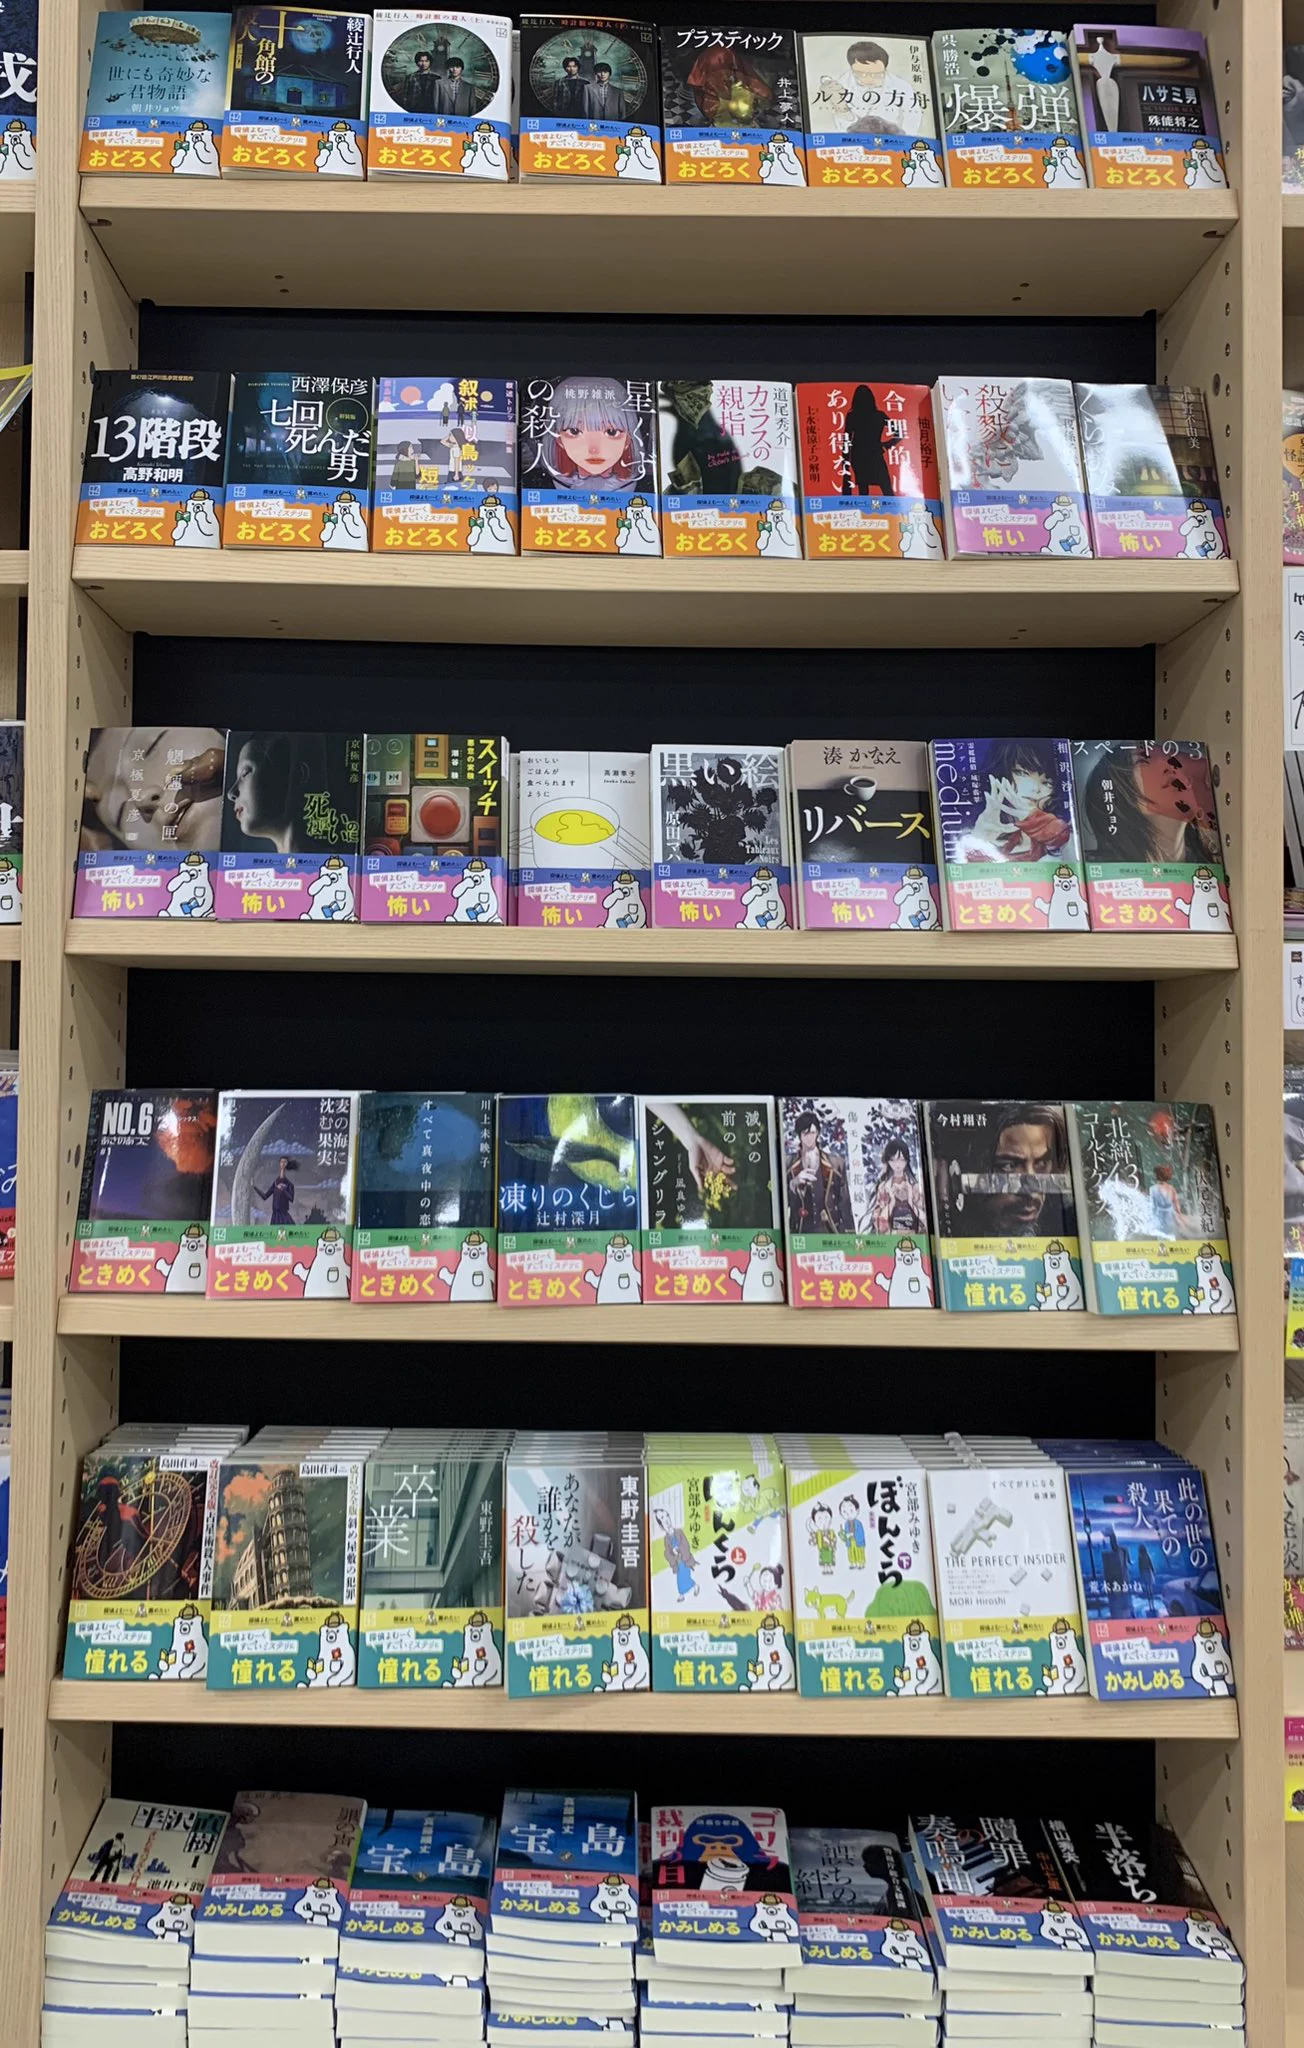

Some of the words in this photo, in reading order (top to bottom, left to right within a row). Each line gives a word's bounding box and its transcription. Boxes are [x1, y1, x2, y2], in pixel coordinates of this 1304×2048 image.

[345, 17, 364, 74] 綾辻行人
[676, 31, 784, 50] プラスティック
[109, 65, 211, 84] 世にも奇妙な
[128, 84, 187, 100] 君物語
[777, 78, 796, 125] 井上夢人
[812, 89, 930, 109] ルカの方舟
[1142, 85, 1198, 104] ハサミ男
[131, 103, 180, 113] 朝井リョウ
[945, 84, 1077, 131] 爆弾
[1148, 115, 1200, 128] 殊能将之
[88, 150, 164, 169] おどろく
[232, 145, 306, 168] おどろく
[378, 147, 451, 168] おどろく
[533, 152, 606, 171] おどろく
[678, 162, 750, 179] おどろく
[822, 167, 894, 184] おどろく
[963, 167, 1035, 185] おどろく
[1106, 167, 1177, 186] おどろく
[291, 376, 368, 395] 西澤保彦
[564, 387, 616, 401] 桃野雑派
[260, 399, 324, 428] 七回
[717, 385, 746, 437] 親指
[772, 387, 791, 447] 道尾秀介
[521, 379, 569, 476] の殺人
[620, 379, 657, 482] 星くず
[747, 385, 772, 461] カラスの
[90, 415, 222, 463] 13階段
[285, 426, 370, 457] 死んだ
[826, 389, 856, 493] あり得ない
[122, 467, 183, 482] 高野和明
[327, 453, 359, 482] 男
[90, 522, 164, 540] おどろく
[236, 522, 311, 542] おどろく
[385, 528, 459, 547] おどろく
[535, 528, 606, 548] おどろく
[983, 528, 1024, 548] 怖い
[1119, 532, 1161, 552] 怖い
[676, 533, 747, 552] おどろく
[819, 534, 891, 553] おどろく
[824, 746, 842, 765] 湊
[850, 748, 900, 766] かなえ
[1073, 740, 1206, 760] スペードの3
[477, 739, 498, 816] スイッチ
[660, 752, 780, 789] 黒い絵
[125, 749, 145, 823] 京極夏彦
[161, 749, 185, 842] 魍魎の匣
[935, 742, 964, 862] medium
[1101, 779, 1118, 835] 朝井リョウ
[803, 804, 930, 844] リバース
[665, 811, 681, 862] 原田マハ
[765, 836, 779, 845] Les
[746, 845, 779, 855] Tableaux
[102, 891, 144, 912] 怖い
[242, 892, 284, 913] 怖い
[388, 896, 430, 918] 怖い
[680, 901, 721, 922] 怖い
[832, 902, 874, 923] 怖い
[542, 905, 583, 926] 怖い
[959, 904, 1033, 924] ときめく
[1100, 904, 1174, 923] ときめく
[102, 1103, 154, 1135] NO.6
[721, 1111, 737, 1143] 前の
[937, 1114, 987, 1128] 今村翔吾
[101, 1137, 149, 1146] あさのあつこ
[317, 1099, 335, 1165] 沈む果実
[333, 1099, 350, 1164] 麦の海に
[479, 1100, 491, 1168] 川上未映子
[745, 1111, 762, 1163] 滅びの
[419, 1100, 433, 1227] すべて真夜中の恋
[848, 1111, 865, 1205] 傷モノの花嫁
[652, 1124, 667, 1225] シャングリラ
[500, 1182, 636, 1212] 凍りのくじら
[536, 1210, 600, 1226] 辻村深月
[78, 1264, 152, 1285] ときめく
[215, 1269, 289, 1291] ときめく
[361, 1274, 435, 1296] ときめく
[655, 1274, 728, 1296] ときめく
[508, 1277, 582, 1300] ときめく
[800, 1279, 874, 1300] ときめく
[965, 1282, 1027, 1306] 憧れる
[1118, 1287, 1179, 1311] 憧れる
[161, 1458, 199, 1470] 島田荘司
[300, 1464, 339, 1475] 島田荘司
[364, 1464, 439, 1559] 卒業
[563, 1473, 581, 1549] あなたが
[687, 1477, 701, 1550] 宮部みゆき
[1127, 1482, 1152, 1529] 殺人
[538, 1486, 563, 1551] 誰かを
[620, 1475, 641, 1568] 東野圭吾
[906, 1482, 921, 1554] 宮部みゆき
[1153, 1489, 1181, 1556] 果ての
[1177, 1478, 1208, 1568] 此の世の
[479, 1500, 493, 1566] 東野圭吾
[867, 1476, 904, 1588] ぼんくら
[511, 1515, 540, 1594] 殺した
[731, 1548, 745, 1564] 上
[898, 1553, 911, 1570] 下
[945, 1557, 966, 1568] THE
[971, 1556, 1018, 1567] PERFECT
[1023, 1553, 1066, 1565] INSIDER
[1089, 1582, 1143, 1594] 荒木あかね
[949, 1597, 974, 1606] MORI
[976, 1597, 1006, 1606] Hiroshi
[85, 1648, 148, 1674] 憧れる
[232, 1659, 295, 1685] 憧れる
[378, 1658, 441, 1684] 憧れる
[529, 1664, 592, 1692] 憧れる
[674, 1660, 737, 1686] 憧れる
[820, 1667, 884, 1692] 憧れる
[971, 1666, 1033, 1692] 憧れる
[1105, 1671, 1184, 1691] かみしめる
[510, 1823, 626, 1857] 宝島
[656, 1809, 686, 1885] 裁判の日
[750, 1808, 782, 1870] ゴリラ
[364, 1843, 483, 1877] 宝島
[917, 1814, 974, 1895] 奏鳴曲
[1095, 1822, 1158, 1903] 半落ち
[204, 1903, 283, 1917] かみしめる
[501, 1898, 580, 1914] かみしめる
[57, 1909, 137, 1930] かみしめる
[345, 1919, 425, 1935] かみしめる
[659, 1920, 740, 1935] かみしめる
[950, 1925, 1033, 1942] かみしめる
[1097, 1932, 1181, 1951] かみしめる
[802, 1945, 873, 1960] みしめる
